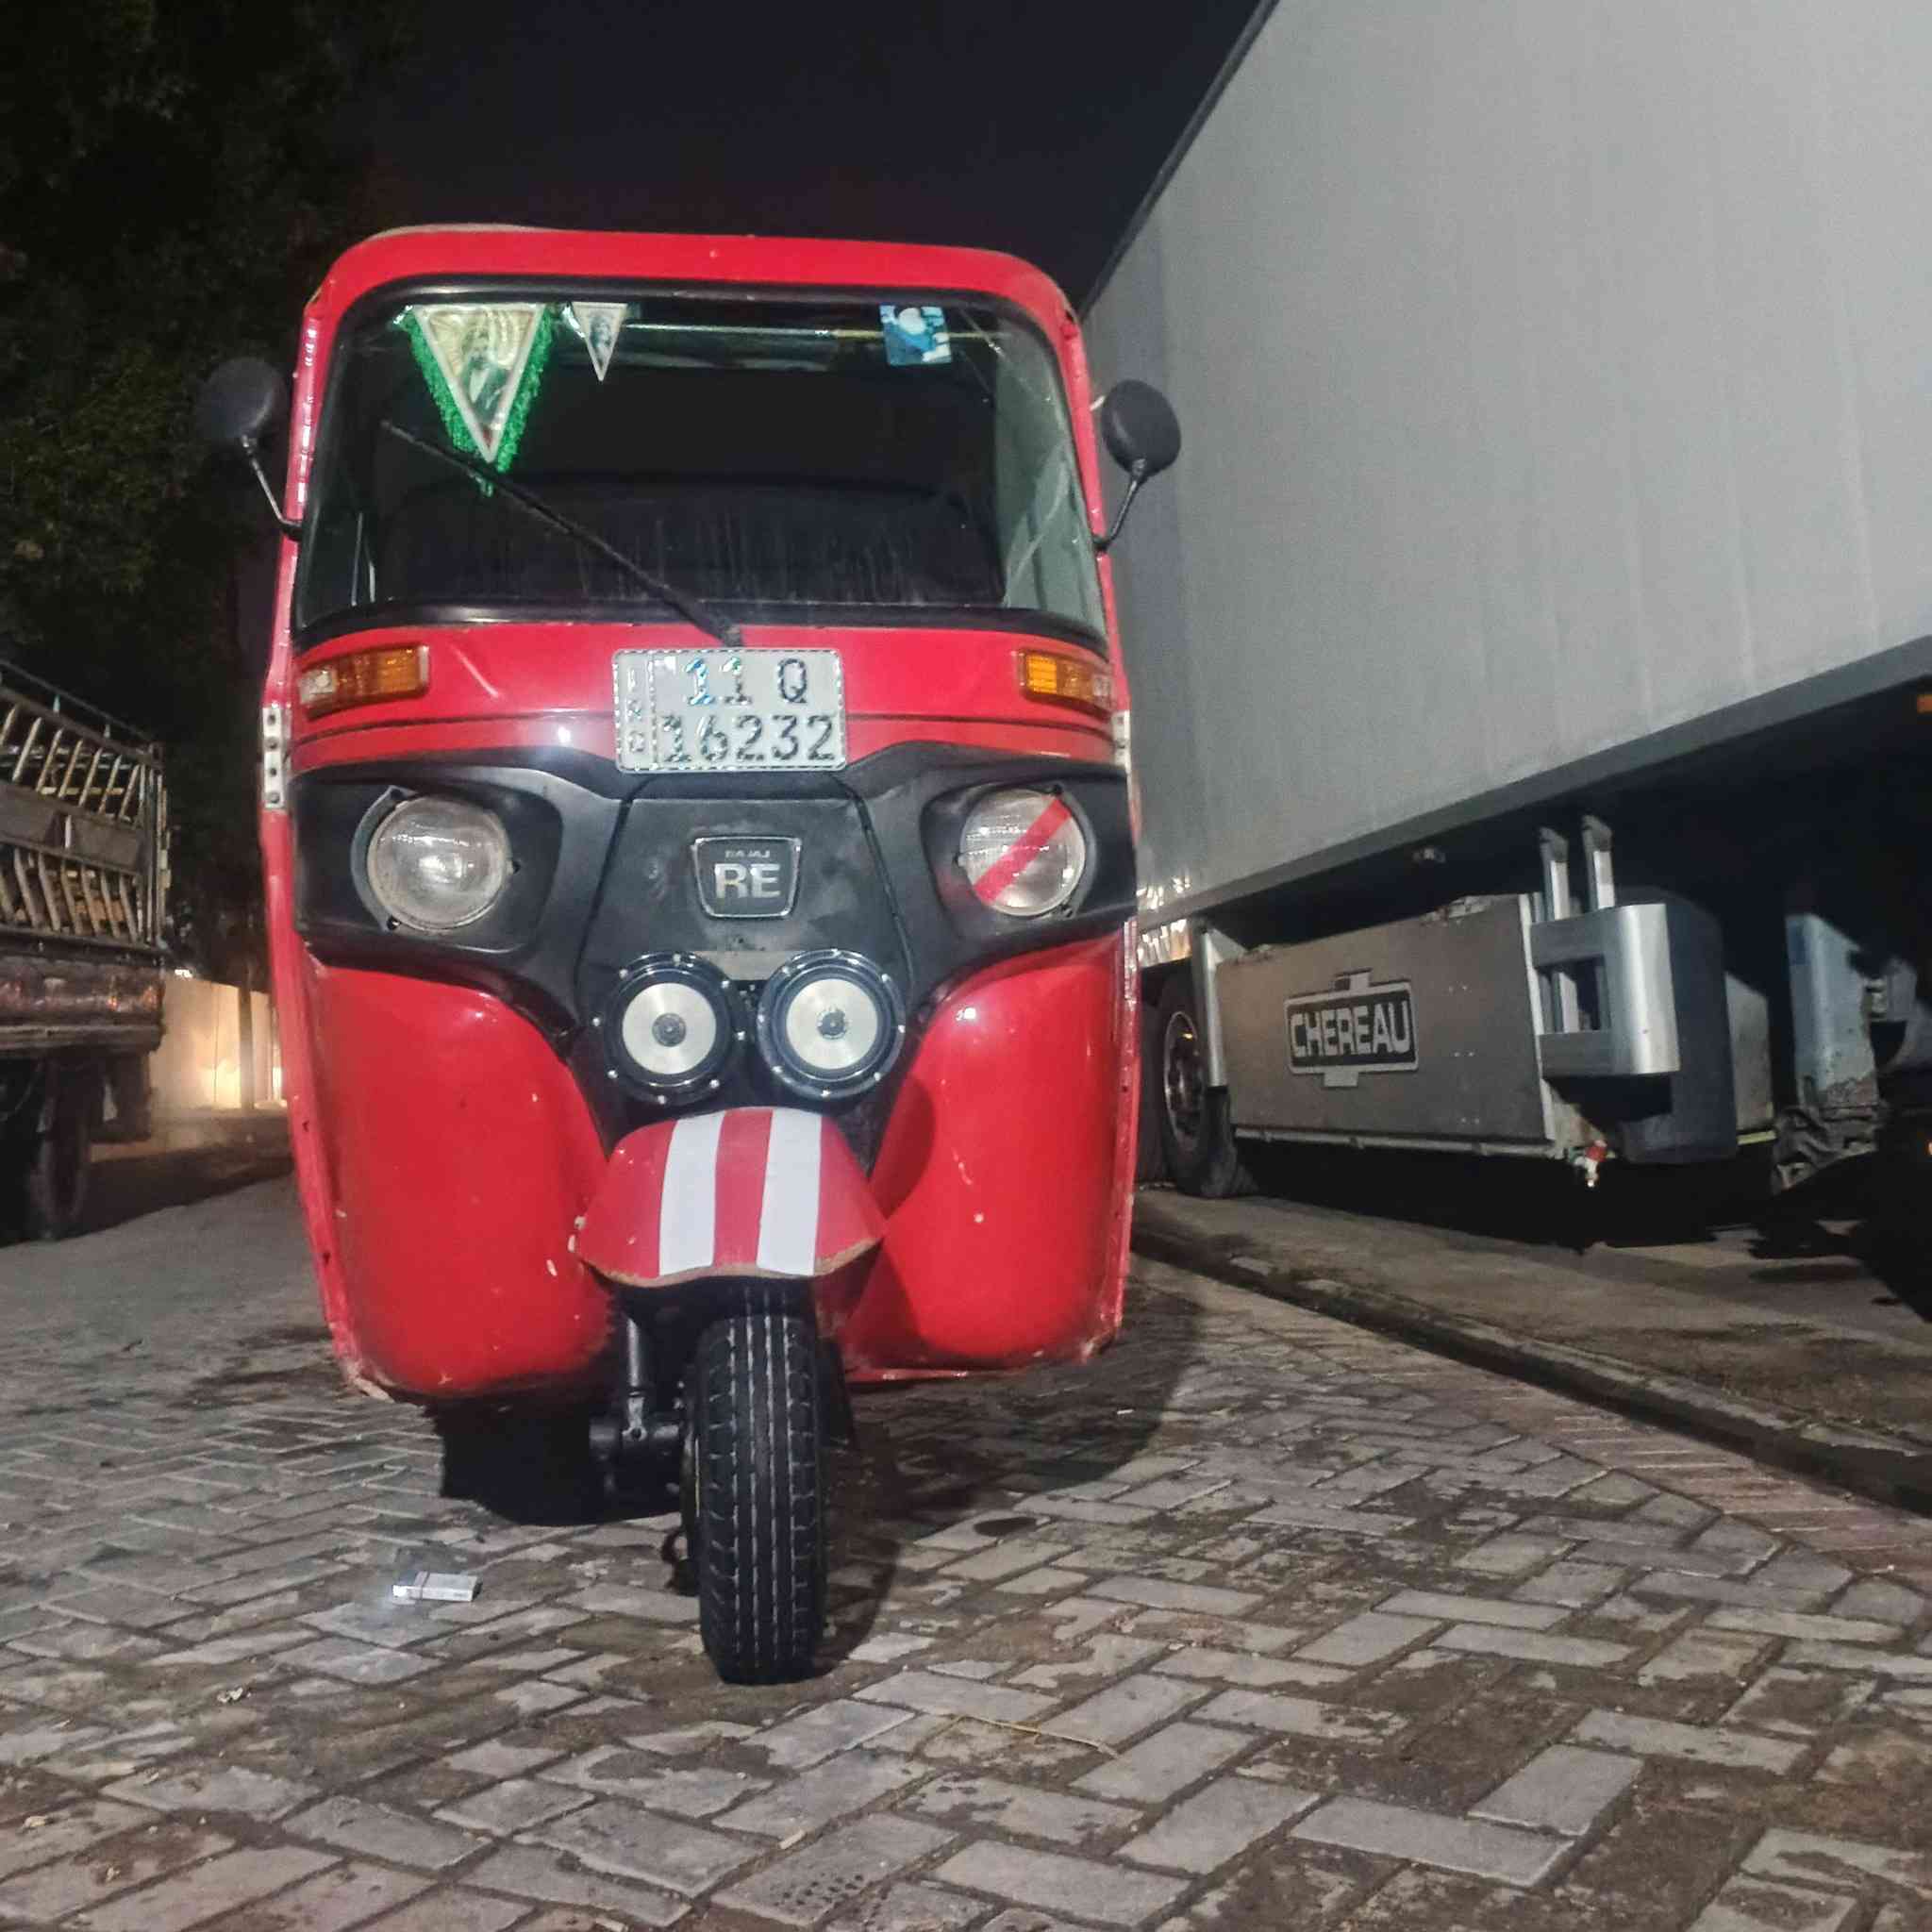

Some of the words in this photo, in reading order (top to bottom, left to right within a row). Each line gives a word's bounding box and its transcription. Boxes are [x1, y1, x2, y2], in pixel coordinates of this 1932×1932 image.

[684, 658, 753, 706] 11
[777, 658, 808, 704] Q
[662, 714, 836, 762] 16232
[714, 863, 781, 899] RE
[1290, 1000, 1411, 1058] CHEREAU
